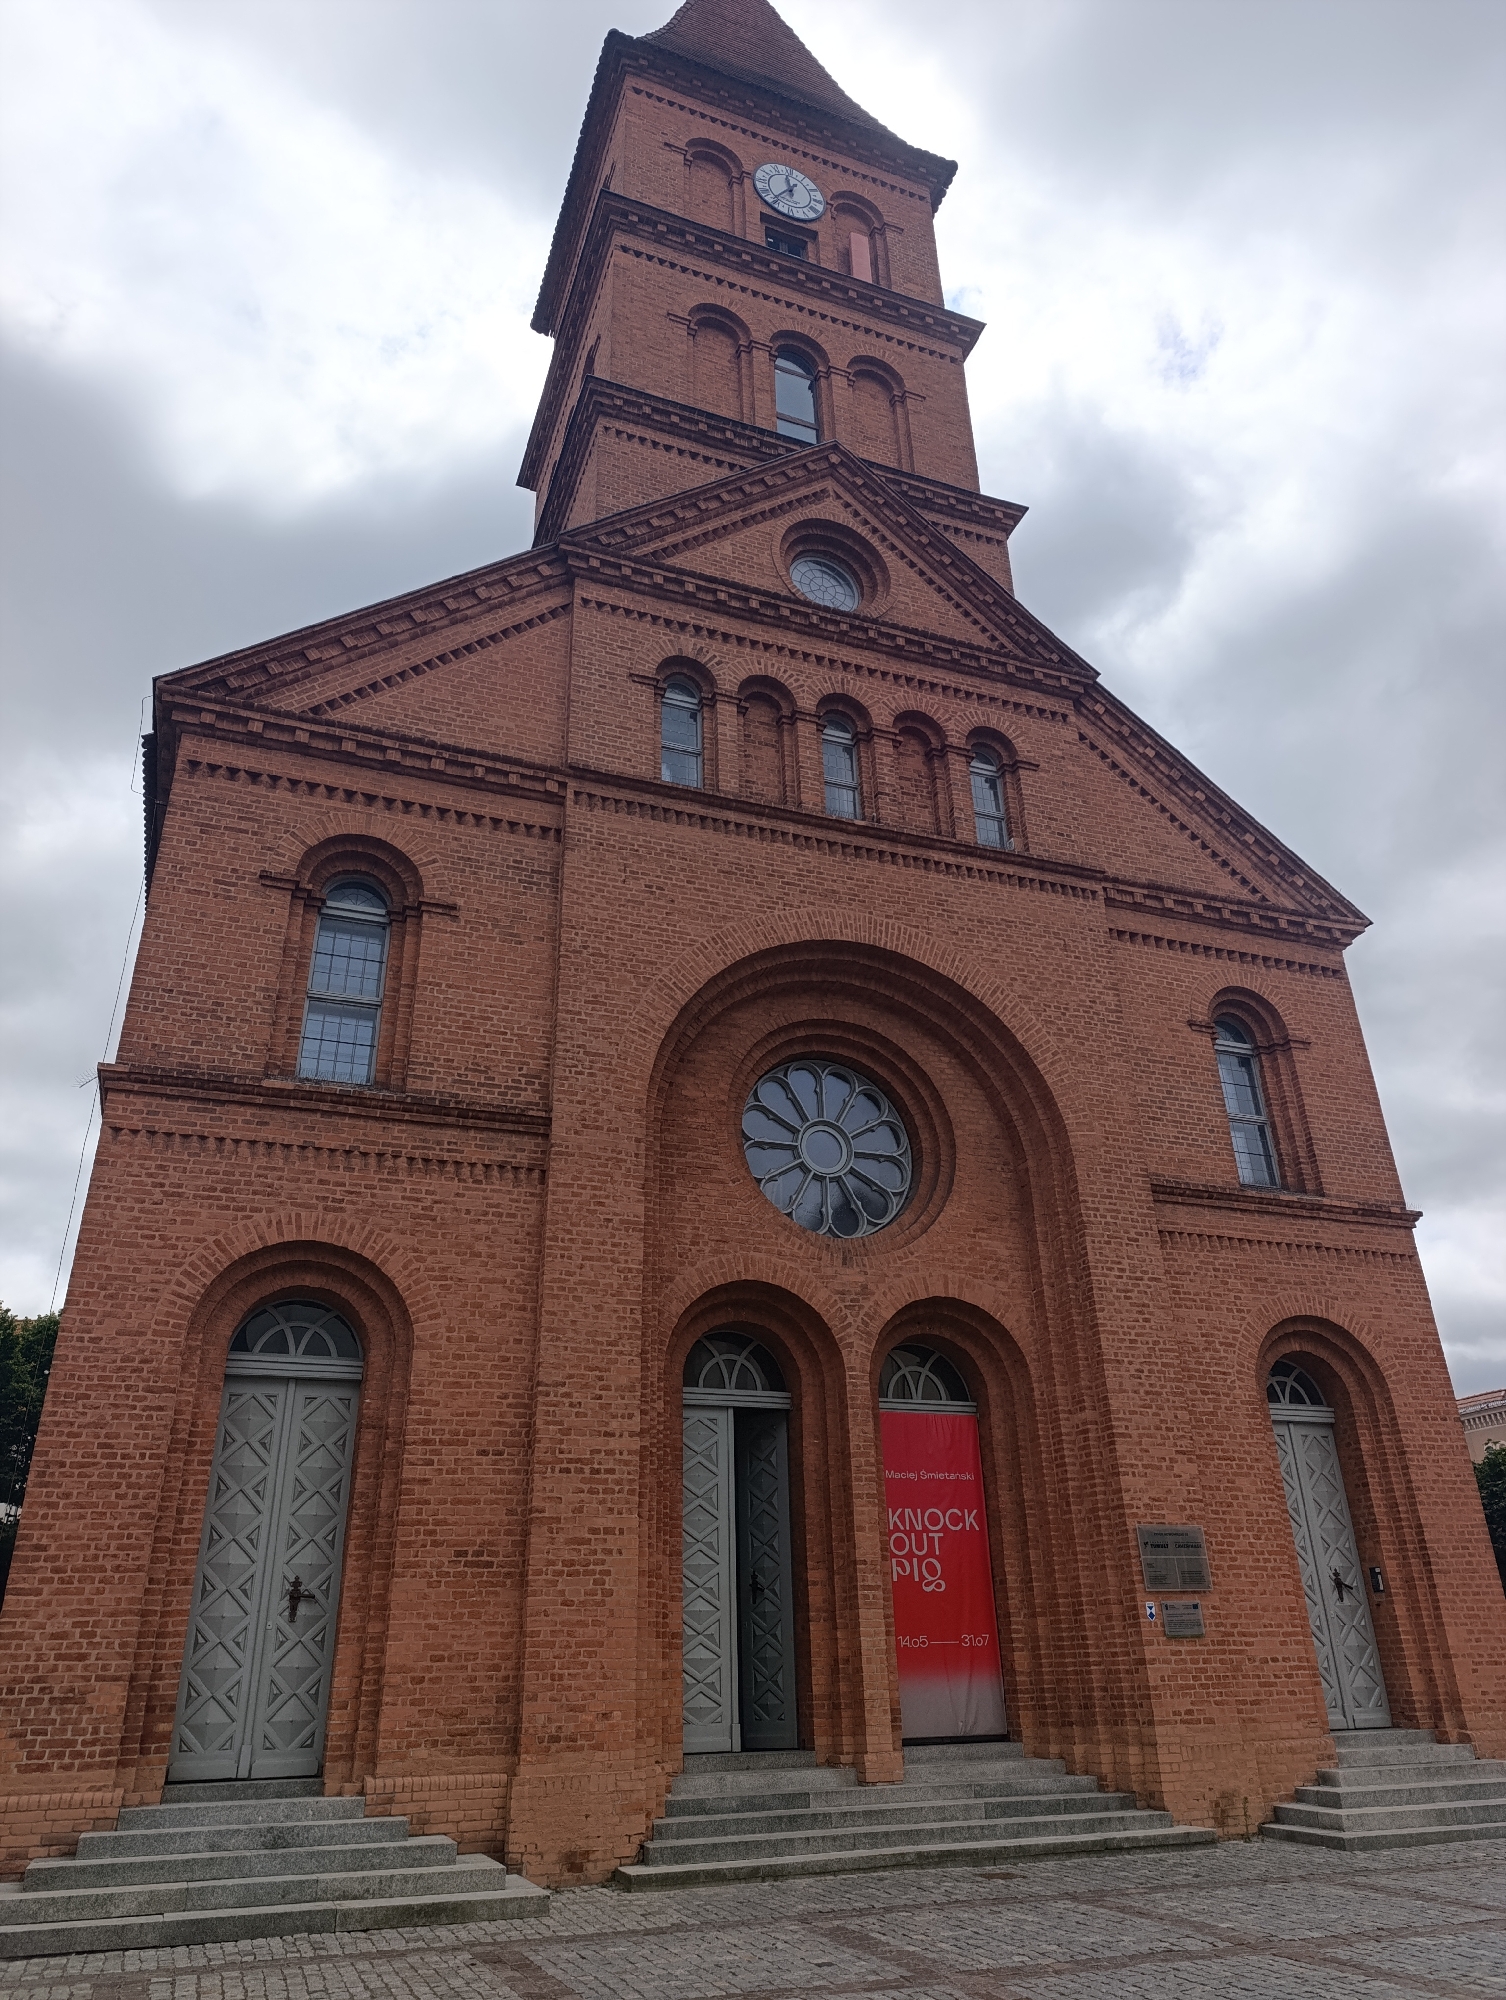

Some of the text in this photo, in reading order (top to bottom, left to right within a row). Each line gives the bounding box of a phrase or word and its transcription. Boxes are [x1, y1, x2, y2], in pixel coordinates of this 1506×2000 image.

[885, 1470, 918, 1482] Maciej
[888, 1507, 980, 1531] KNOCK
[889, 1532, 944, 1556] OUT
[897, 1635, 929, 1648] 14.05
[961, 1634, 990, 1647] 31.07
